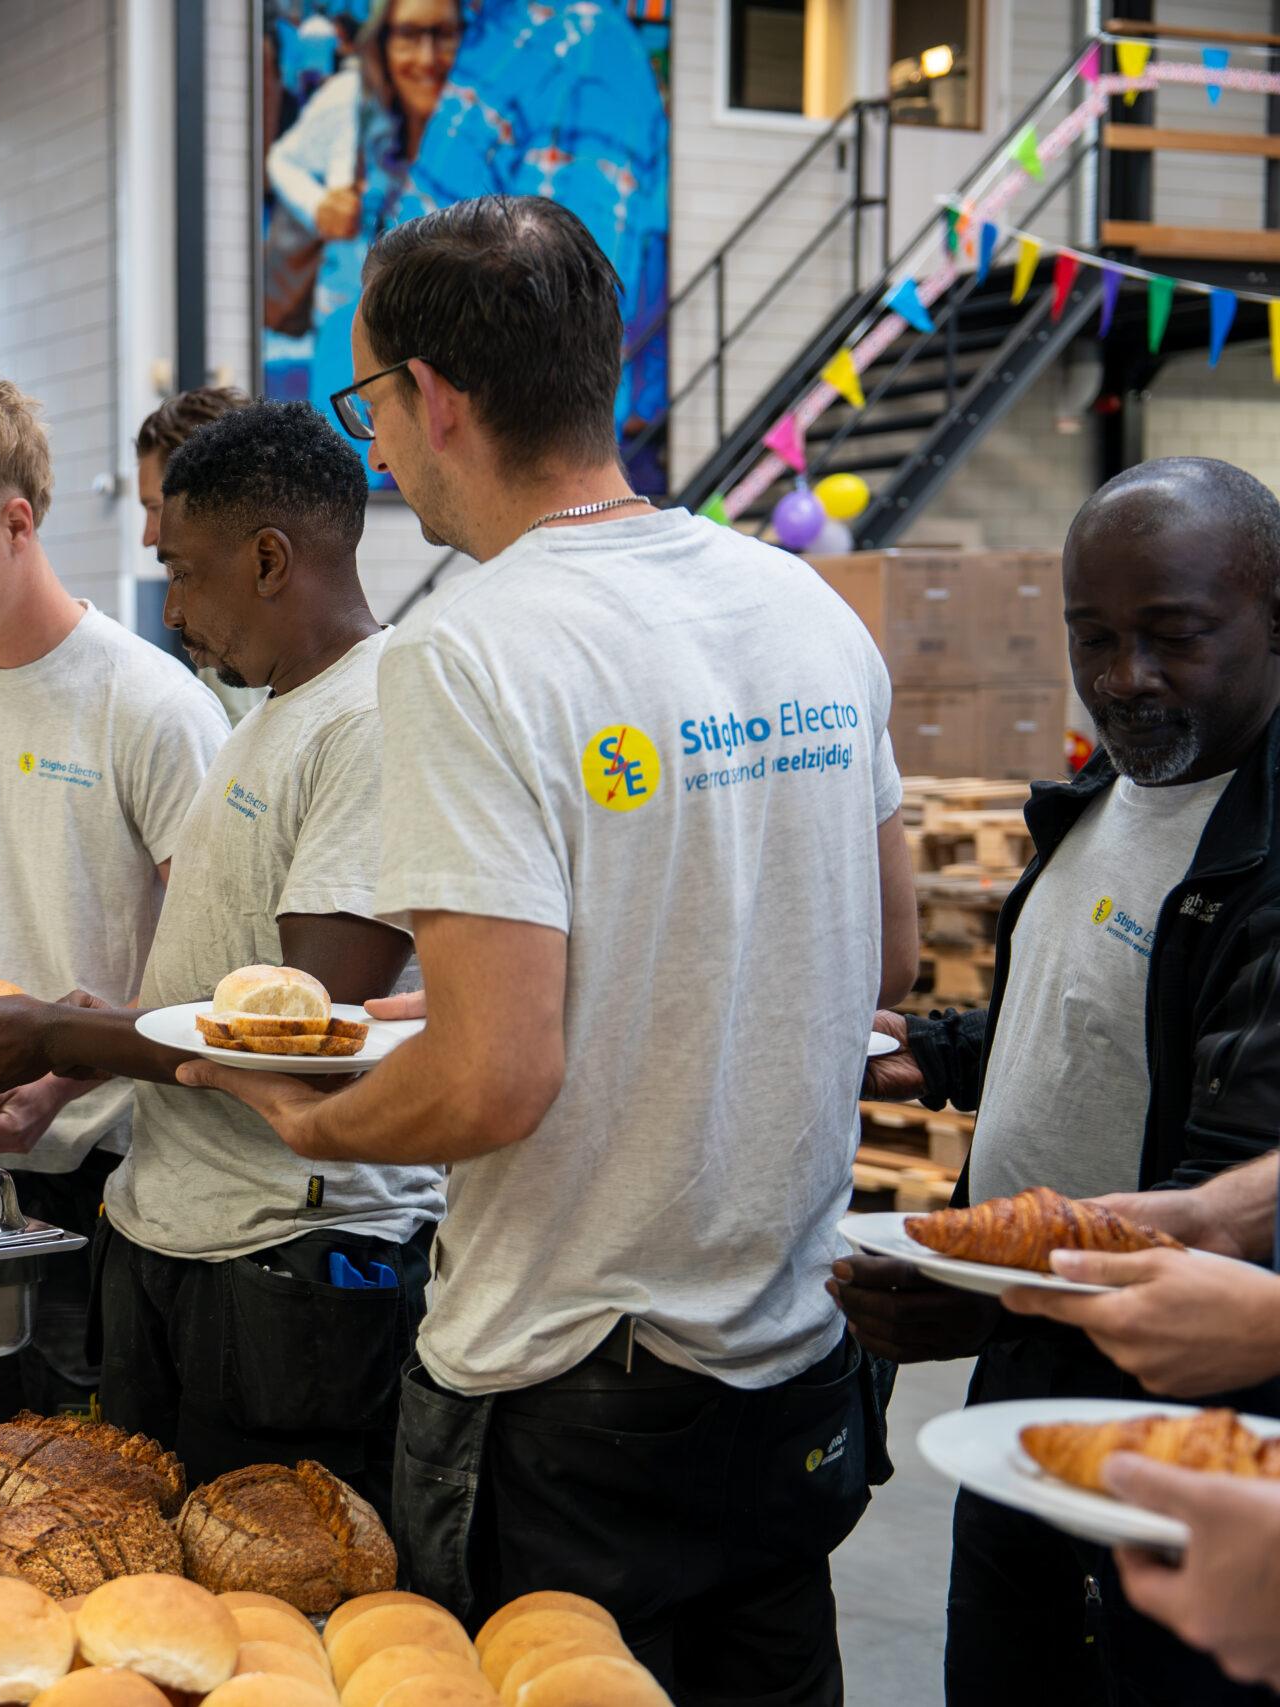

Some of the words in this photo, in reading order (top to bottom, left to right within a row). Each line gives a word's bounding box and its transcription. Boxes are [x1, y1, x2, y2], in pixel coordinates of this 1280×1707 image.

[680, 712, 770, 757] Stigho
[780, 699, 858, 737] Electro
[40, 758, 67, 772] Stigho
[67, 763, 103, 780] Electro
[684, 756, 765, 791] verrasnd
[1113, 911, 1143, 936] Stigho
